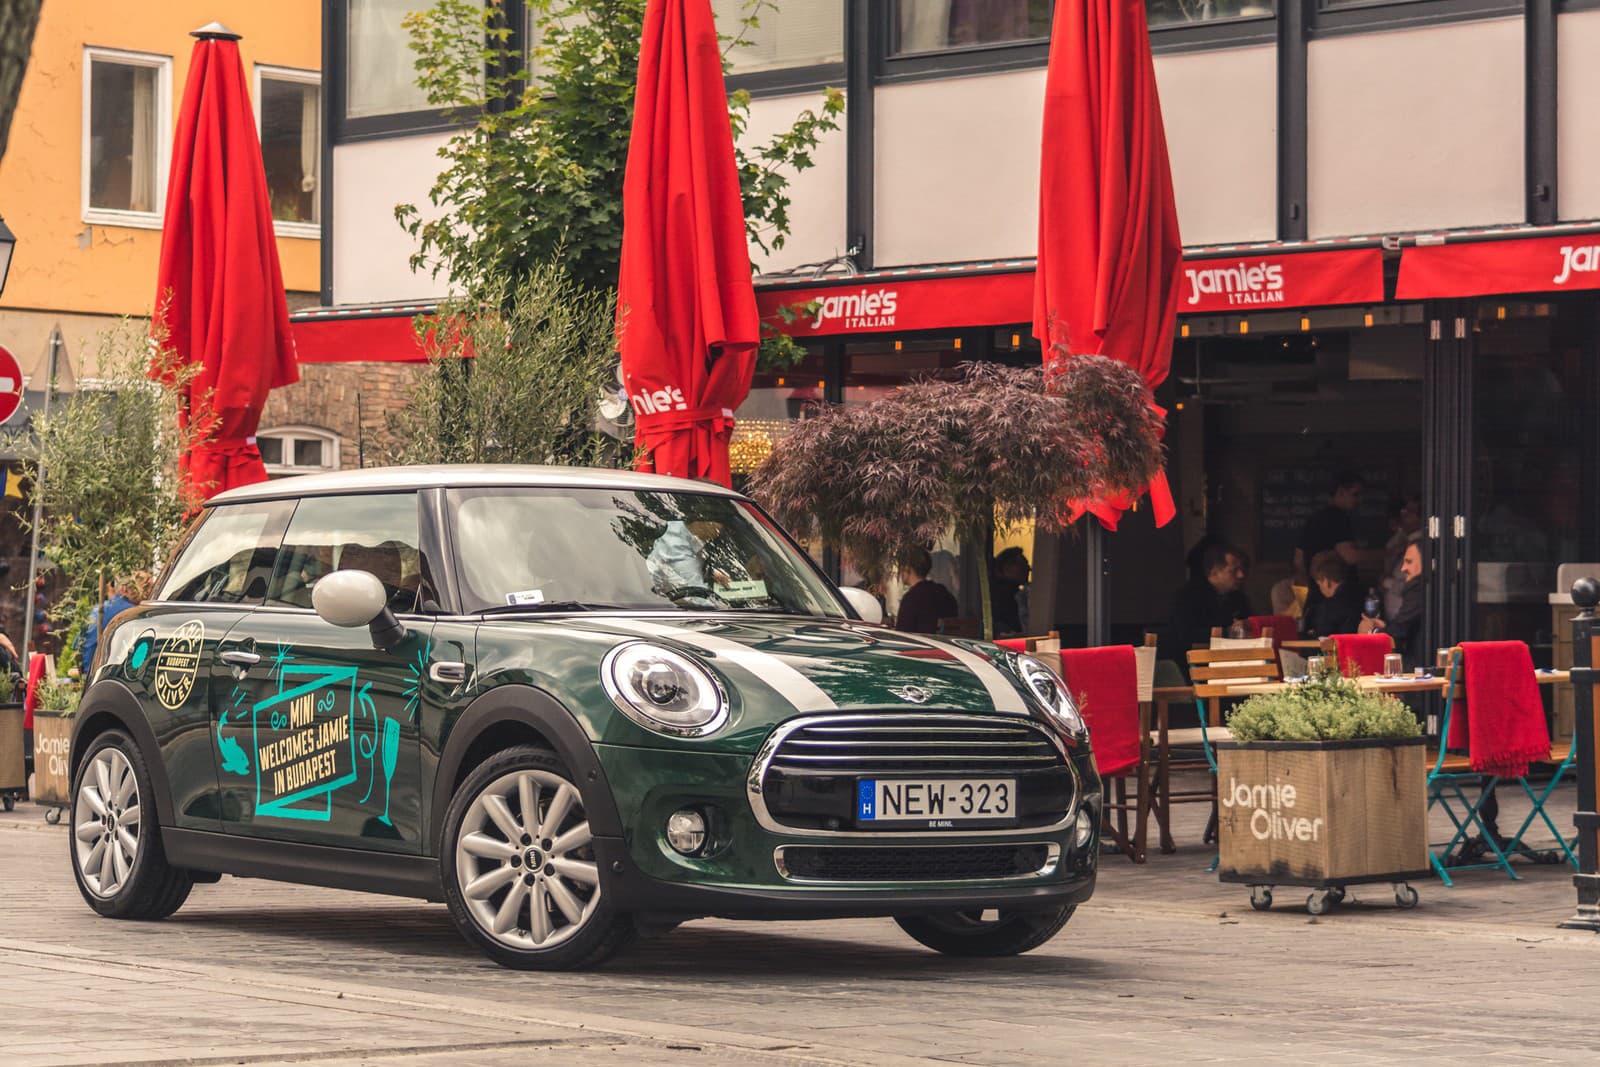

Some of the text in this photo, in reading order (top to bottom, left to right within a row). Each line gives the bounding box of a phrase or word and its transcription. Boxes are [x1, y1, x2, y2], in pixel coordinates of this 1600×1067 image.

[1185, 262, 1284, 305] Jamie's
[1228, 290, 1284, 304] ITALIAN
[811, 289, 898, 329] Jamie's
[845, 316, 896, 328] ITALIAN
[166, 656, 190, 667] BUDAPEST
[158, 674, 192, 704] OLIVER
[289, 693, 315, 730] MINI
[36, 733, 70, 754] Jamie
[259, 714, 349, 772] WELCOMES JAMIE
[274, 749, 336, 796] IN BUDAPEST
[863, 783, 1009, 815] H NEW-323
[1223, 777, 1296, 809] Jamie
[1250, 808, 1324, 841] Oliver
